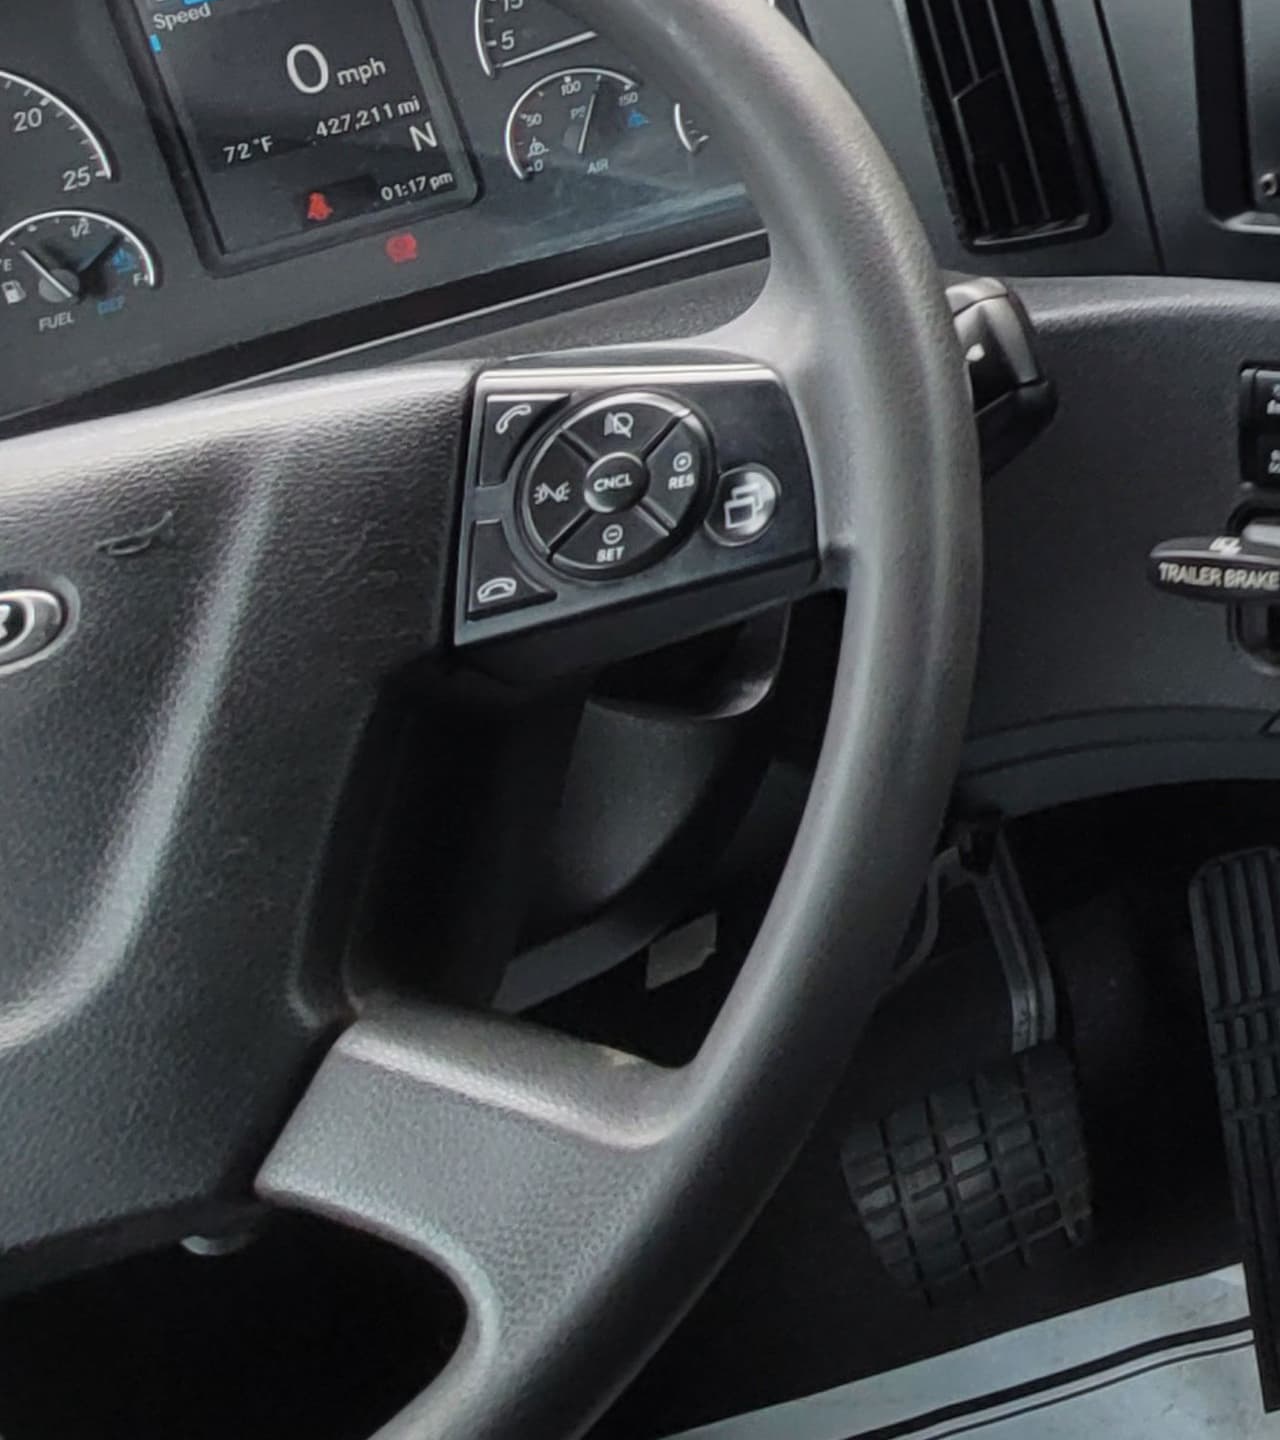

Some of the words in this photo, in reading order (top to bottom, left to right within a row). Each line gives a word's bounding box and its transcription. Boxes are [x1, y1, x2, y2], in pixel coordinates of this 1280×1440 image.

[153, 3, 212, 31] Speed
[501, 30, 515, 50] 5
[286, 43, 329, 95] 0
[336, 57, 386, 86] mph
[561, 80, 581, 97] 100
[618, 92, 639, 107] 150
[13, 107, 43, 133] 20
[315, 102, 394, 139] 427,211
[397, 95, 420, 116] mi
[409, 121, 438, 152] N
[587, 159, 609, 174] AIR
[62, 167, 91, 191] 25
[380, 175, 428, 202] 01:17
[430, 171, 454, 191] pm
[4, 258, 12, 272] E
[38, 311, 75, 332] FUEL
[593, 473, 633, 493] CNCL
[667, 475, 695, 491] RES
[596, 546, 625, 563] SET
[1158, 562, 1222, 587] TRAILER
[1224, 568, 1280, 591] BRAKE
